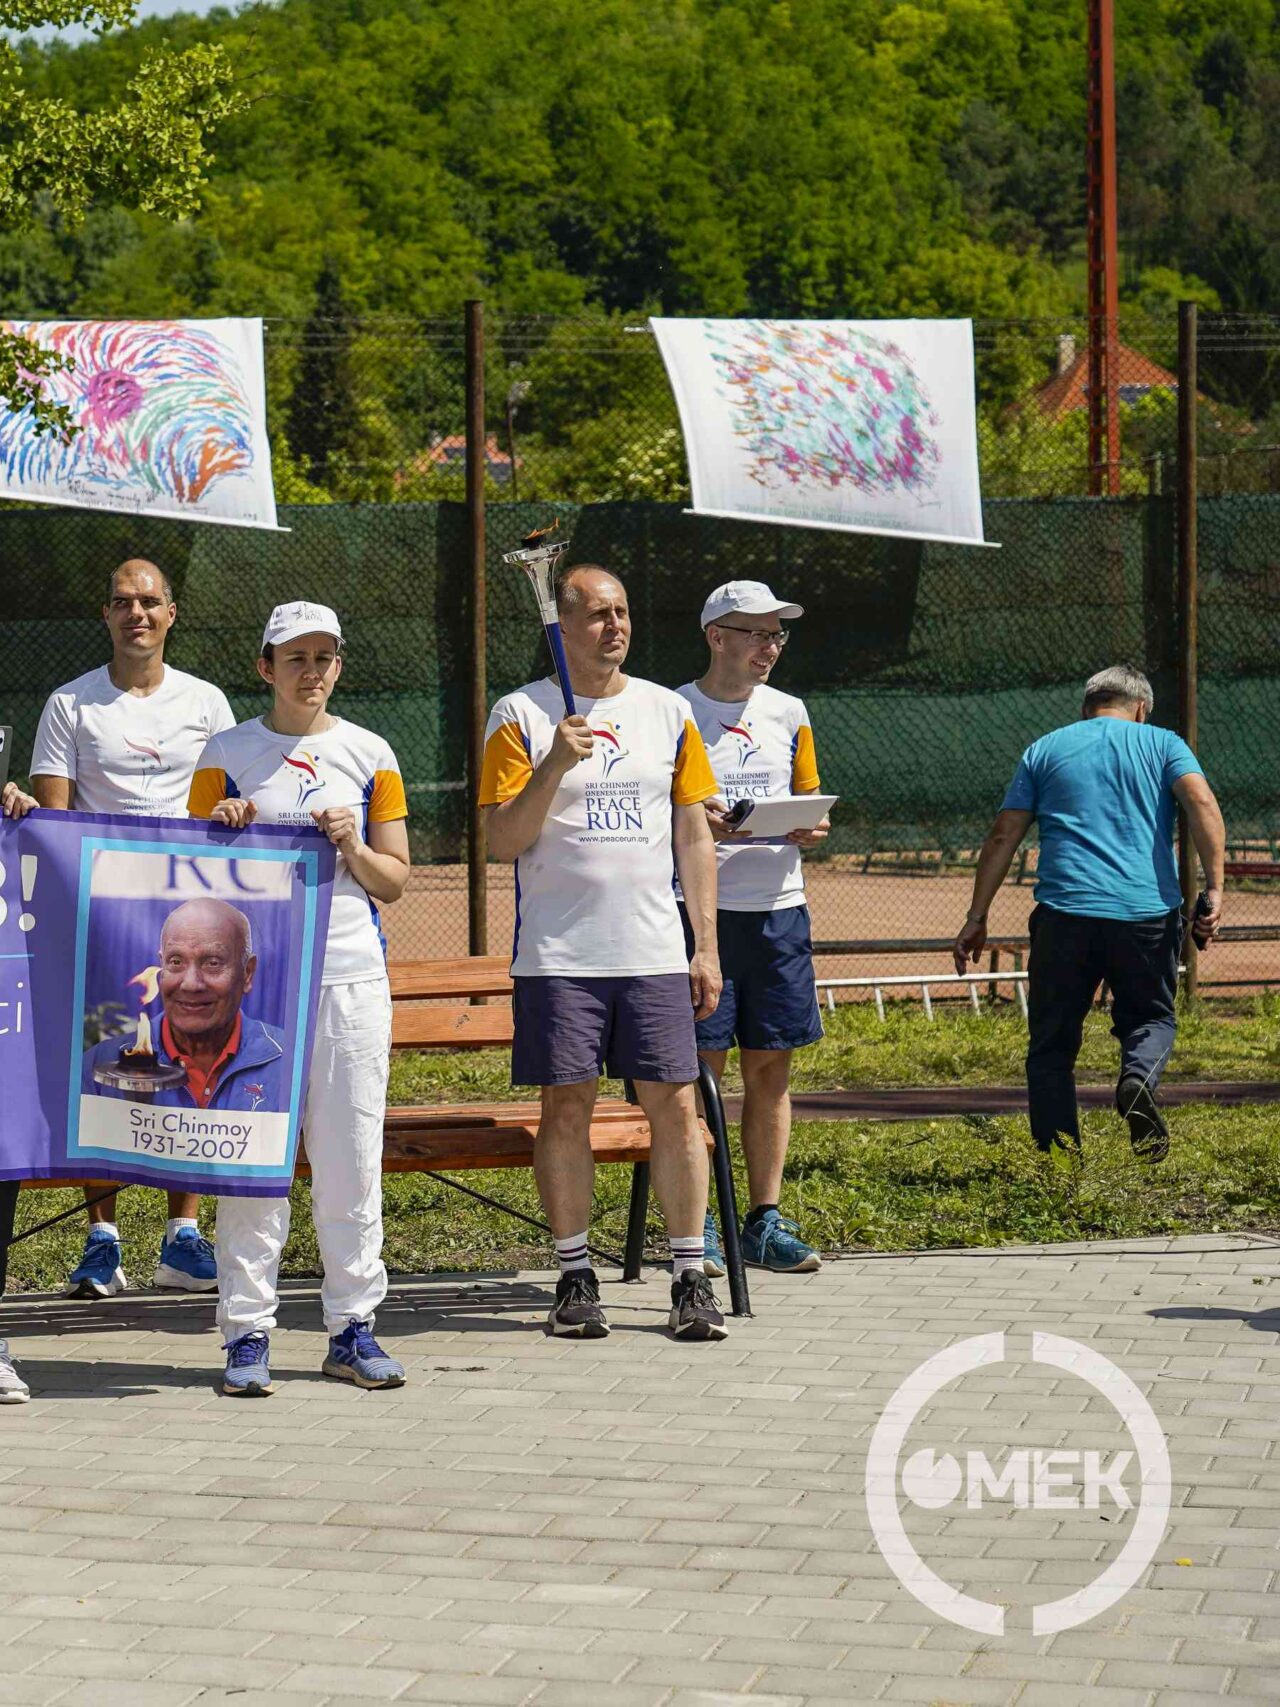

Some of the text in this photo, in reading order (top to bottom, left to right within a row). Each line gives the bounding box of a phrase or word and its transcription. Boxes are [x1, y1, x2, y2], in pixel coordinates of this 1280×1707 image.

[585, 781, 640, 790] SRI CHINMOY
[725, 785, 772, 798] PEACE
[585, 789, 640, 797] ONENESS-HOME
[586, 796, 641, 811] PEACE
[585, 811, 643, 831] RUN
[578, 835, 649, 844] www.peacerun.org
[129, 1108, 253, 1142] Sri Chinmoy
[131, 1130, 249, 1160] 1931-2007
